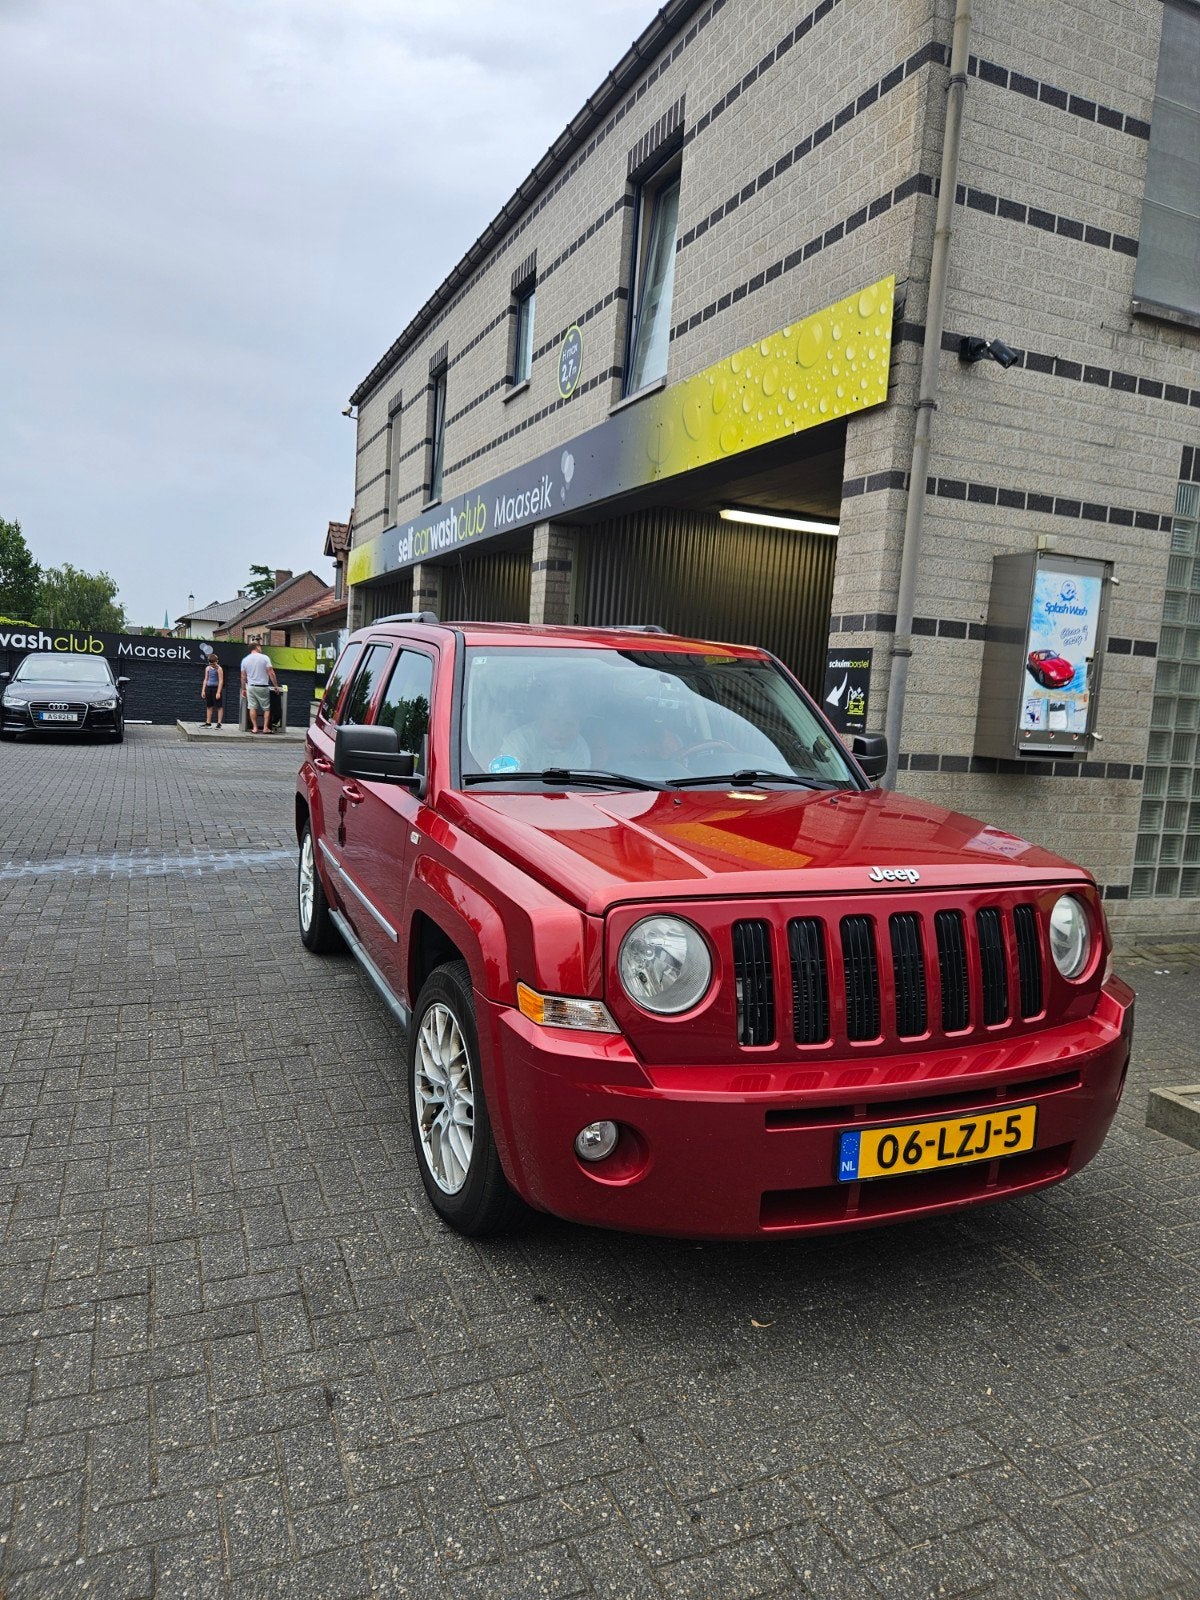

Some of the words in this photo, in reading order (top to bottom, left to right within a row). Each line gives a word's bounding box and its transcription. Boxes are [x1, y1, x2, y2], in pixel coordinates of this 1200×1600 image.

[494, 474, 553, 528] Maaseik
[1045, 602, 1069, 615] Splash
[1069, 605, 1088, 616] Wash
[118, 642, 191, 660] Maaseik
[869, 866, 920, 884] Jeep
[876, 1114, 1022, 1169] 06-LZJ-5
[841, 1161, 856, 1172] NL
